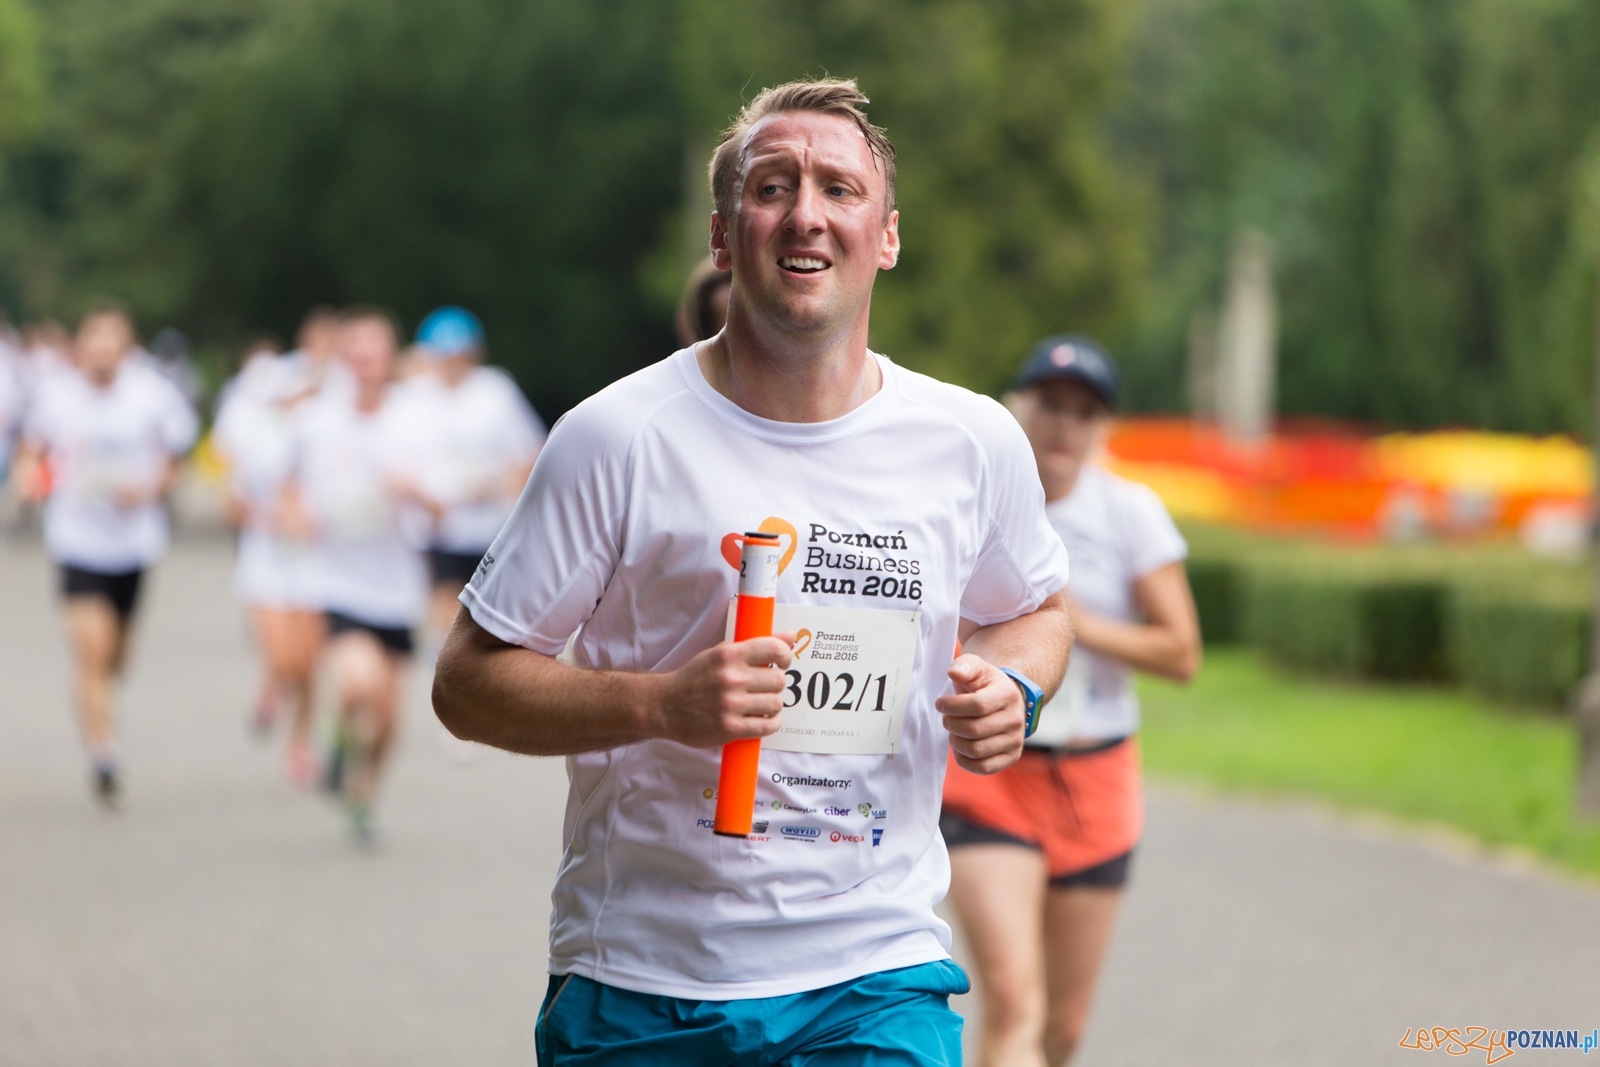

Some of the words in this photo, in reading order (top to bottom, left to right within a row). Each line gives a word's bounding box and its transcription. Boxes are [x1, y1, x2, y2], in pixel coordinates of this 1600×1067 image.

[809, 523, 908, 550] Poznań
[804, 546, 921, 575] Business
[801, 572, 856, 595] Run
[861, 575, 923, 600] 2016
[815, 631, 856, 642] Poznań
[812, 641, 860, 652] Business
[810, 650, 832, 660] Run
[834, 651, 859, 661] 2016
[771, 773, 852, 789] Organizatorzy:
[824, 806, 852, 816] ciber
[785, 827, 816, 836] wavin
